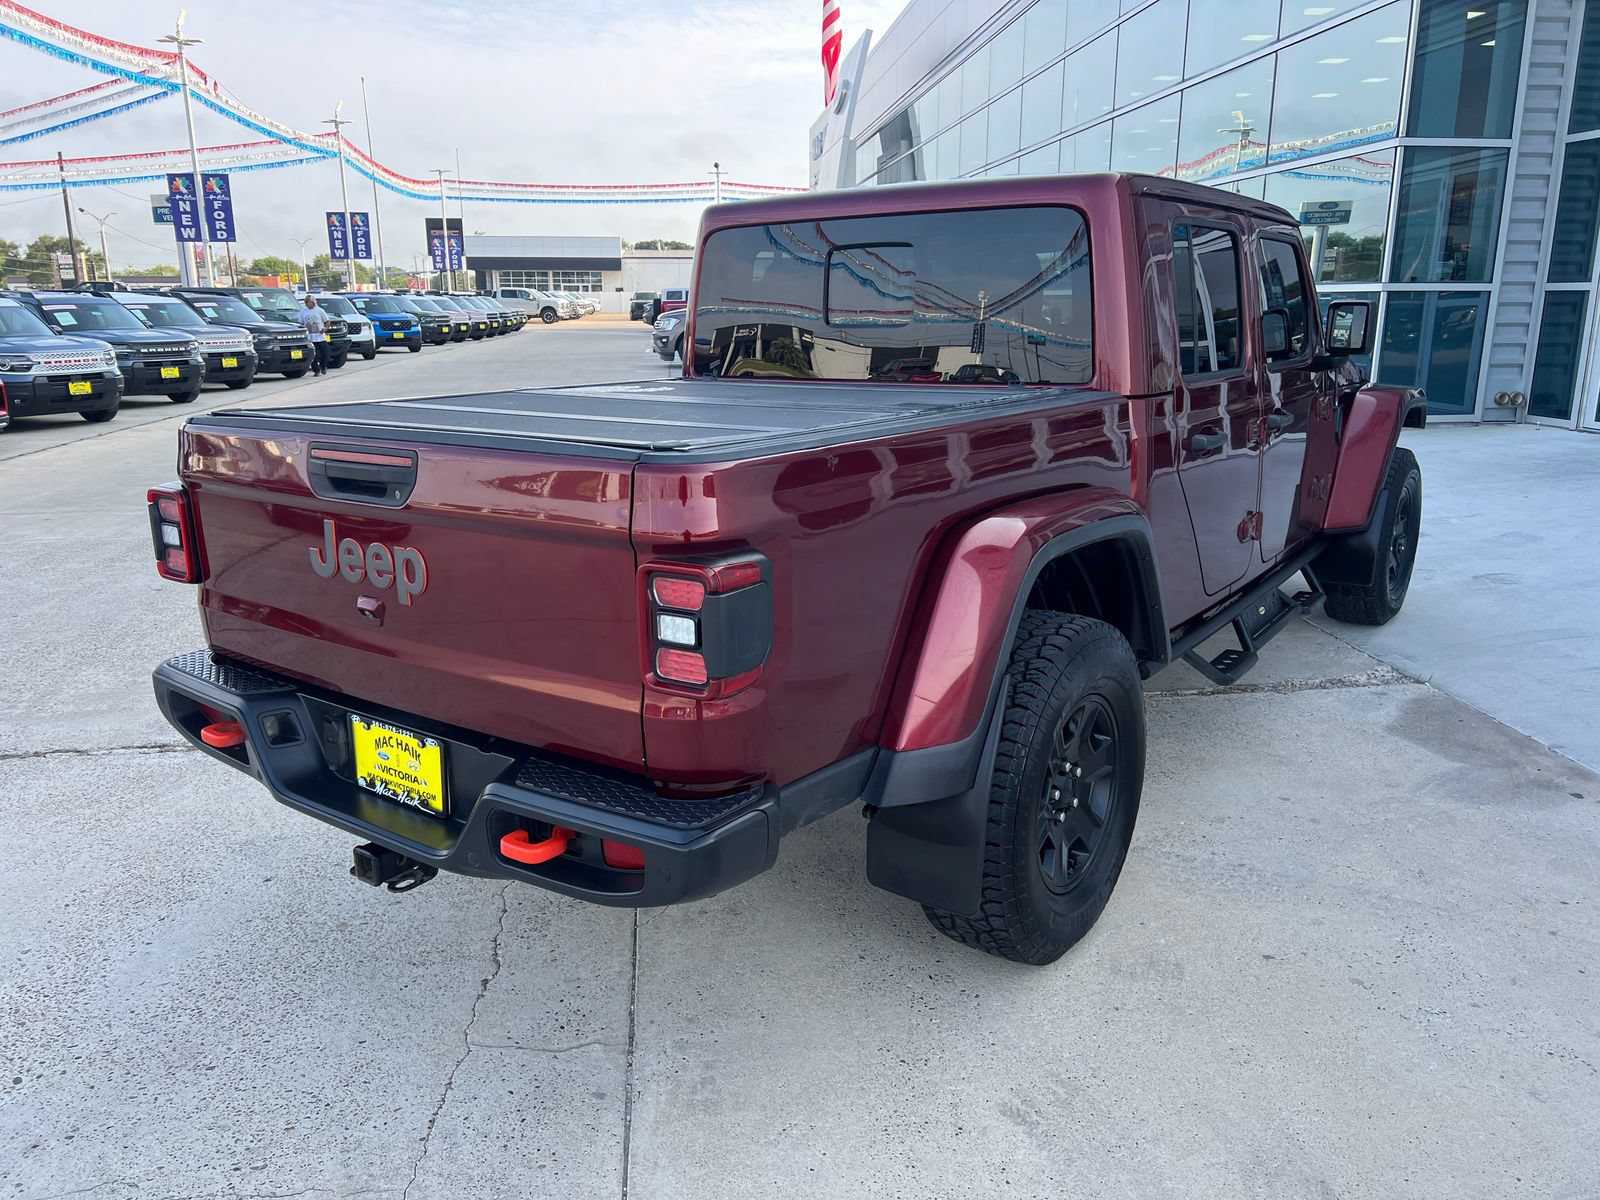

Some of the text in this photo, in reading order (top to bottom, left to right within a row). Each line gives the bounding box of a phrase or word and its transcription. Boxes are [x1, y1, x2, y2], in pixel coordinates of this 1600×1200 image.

[178, 200, 196, 239] NEW
[213, 200, 228, 239] FORD
[333, 230, 345, 257] NEW
[356, 230, 367, 258] FORD
[434, 249, 444, 269] NEW
[451, 249, 459, 270] FORD
[43, 357, 98, 365] BRONCO
[309, 519, 429, 608] Jeep
[375, 736, 395, 751] MAC
[395, 738, 422, 766] HAIK
[379, 764, 420, 786] VICTORIA
[373, 782, 423, 807] Mac Haik
